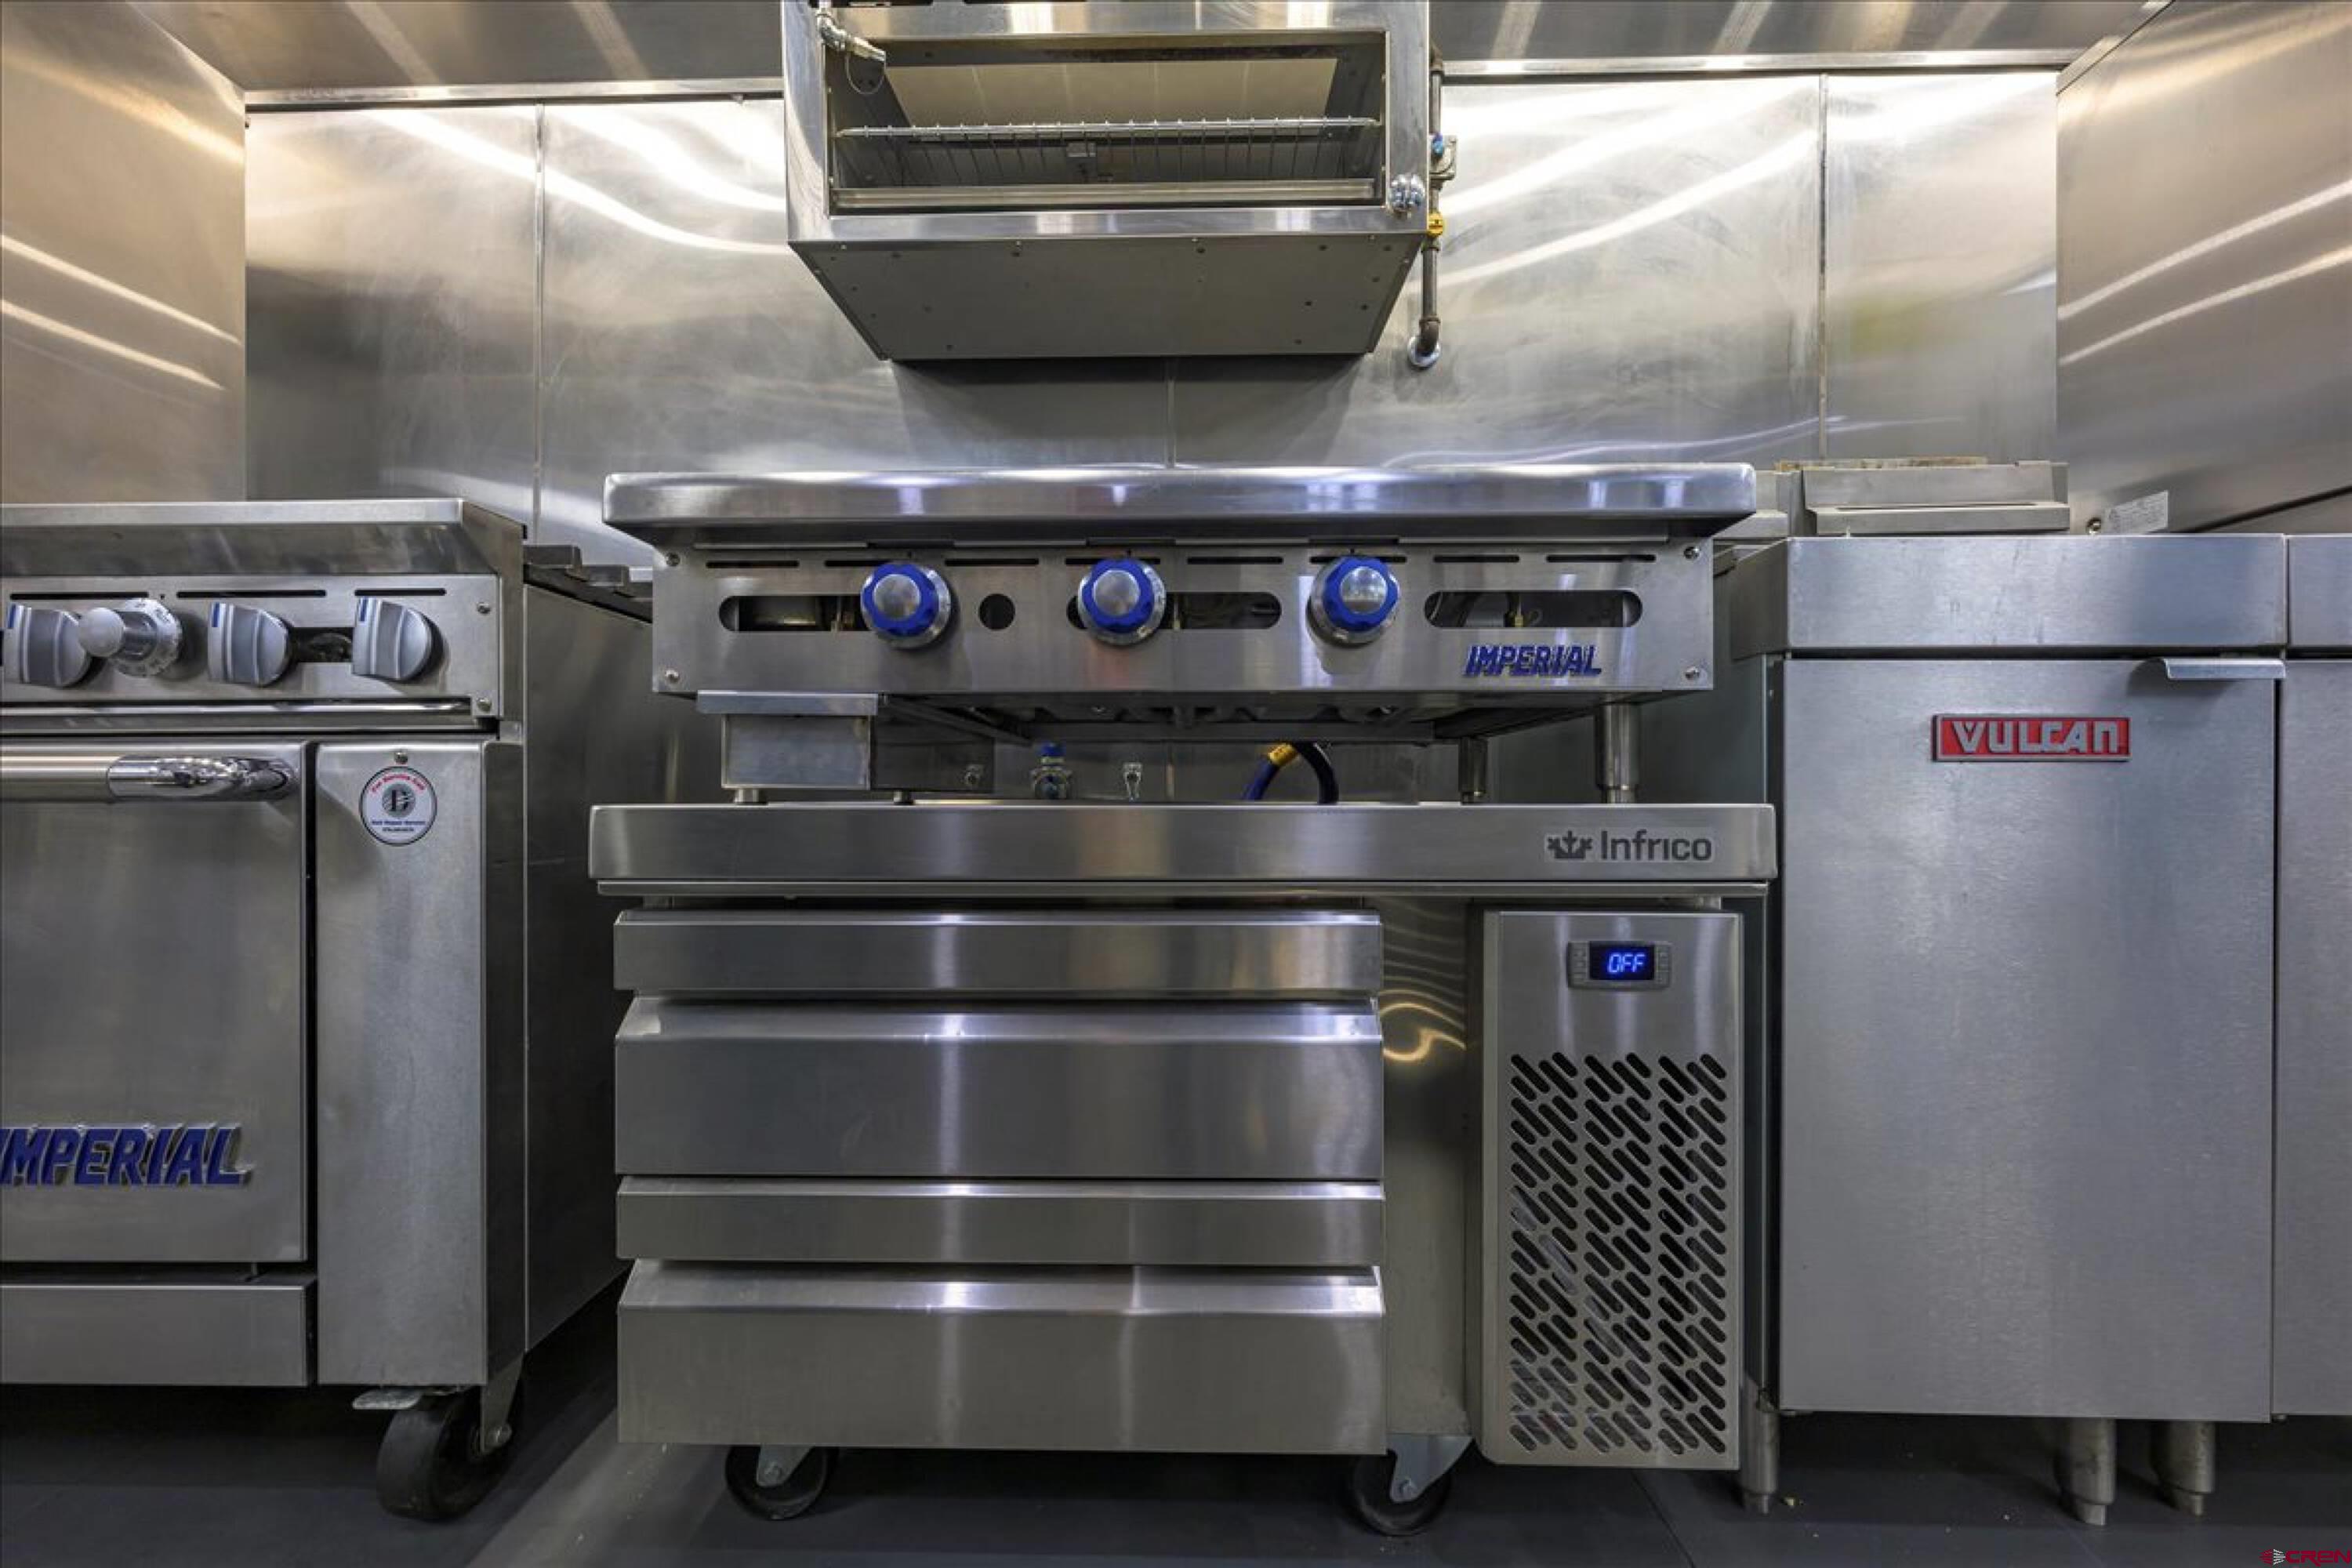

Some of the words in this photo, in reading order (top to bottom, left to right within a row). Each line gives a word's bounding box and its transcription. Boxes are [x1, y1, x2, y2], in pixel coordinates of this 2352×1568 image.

[1465, 644, 1602, 676] IMPERIAL
[1952, 720, 2118, 753] VULCAN
[1601, 828, 1711, 860] Infrico
[1607, 952, 1646, 974] OFF
[0, 1126, 248, 1185] MPERIAL
